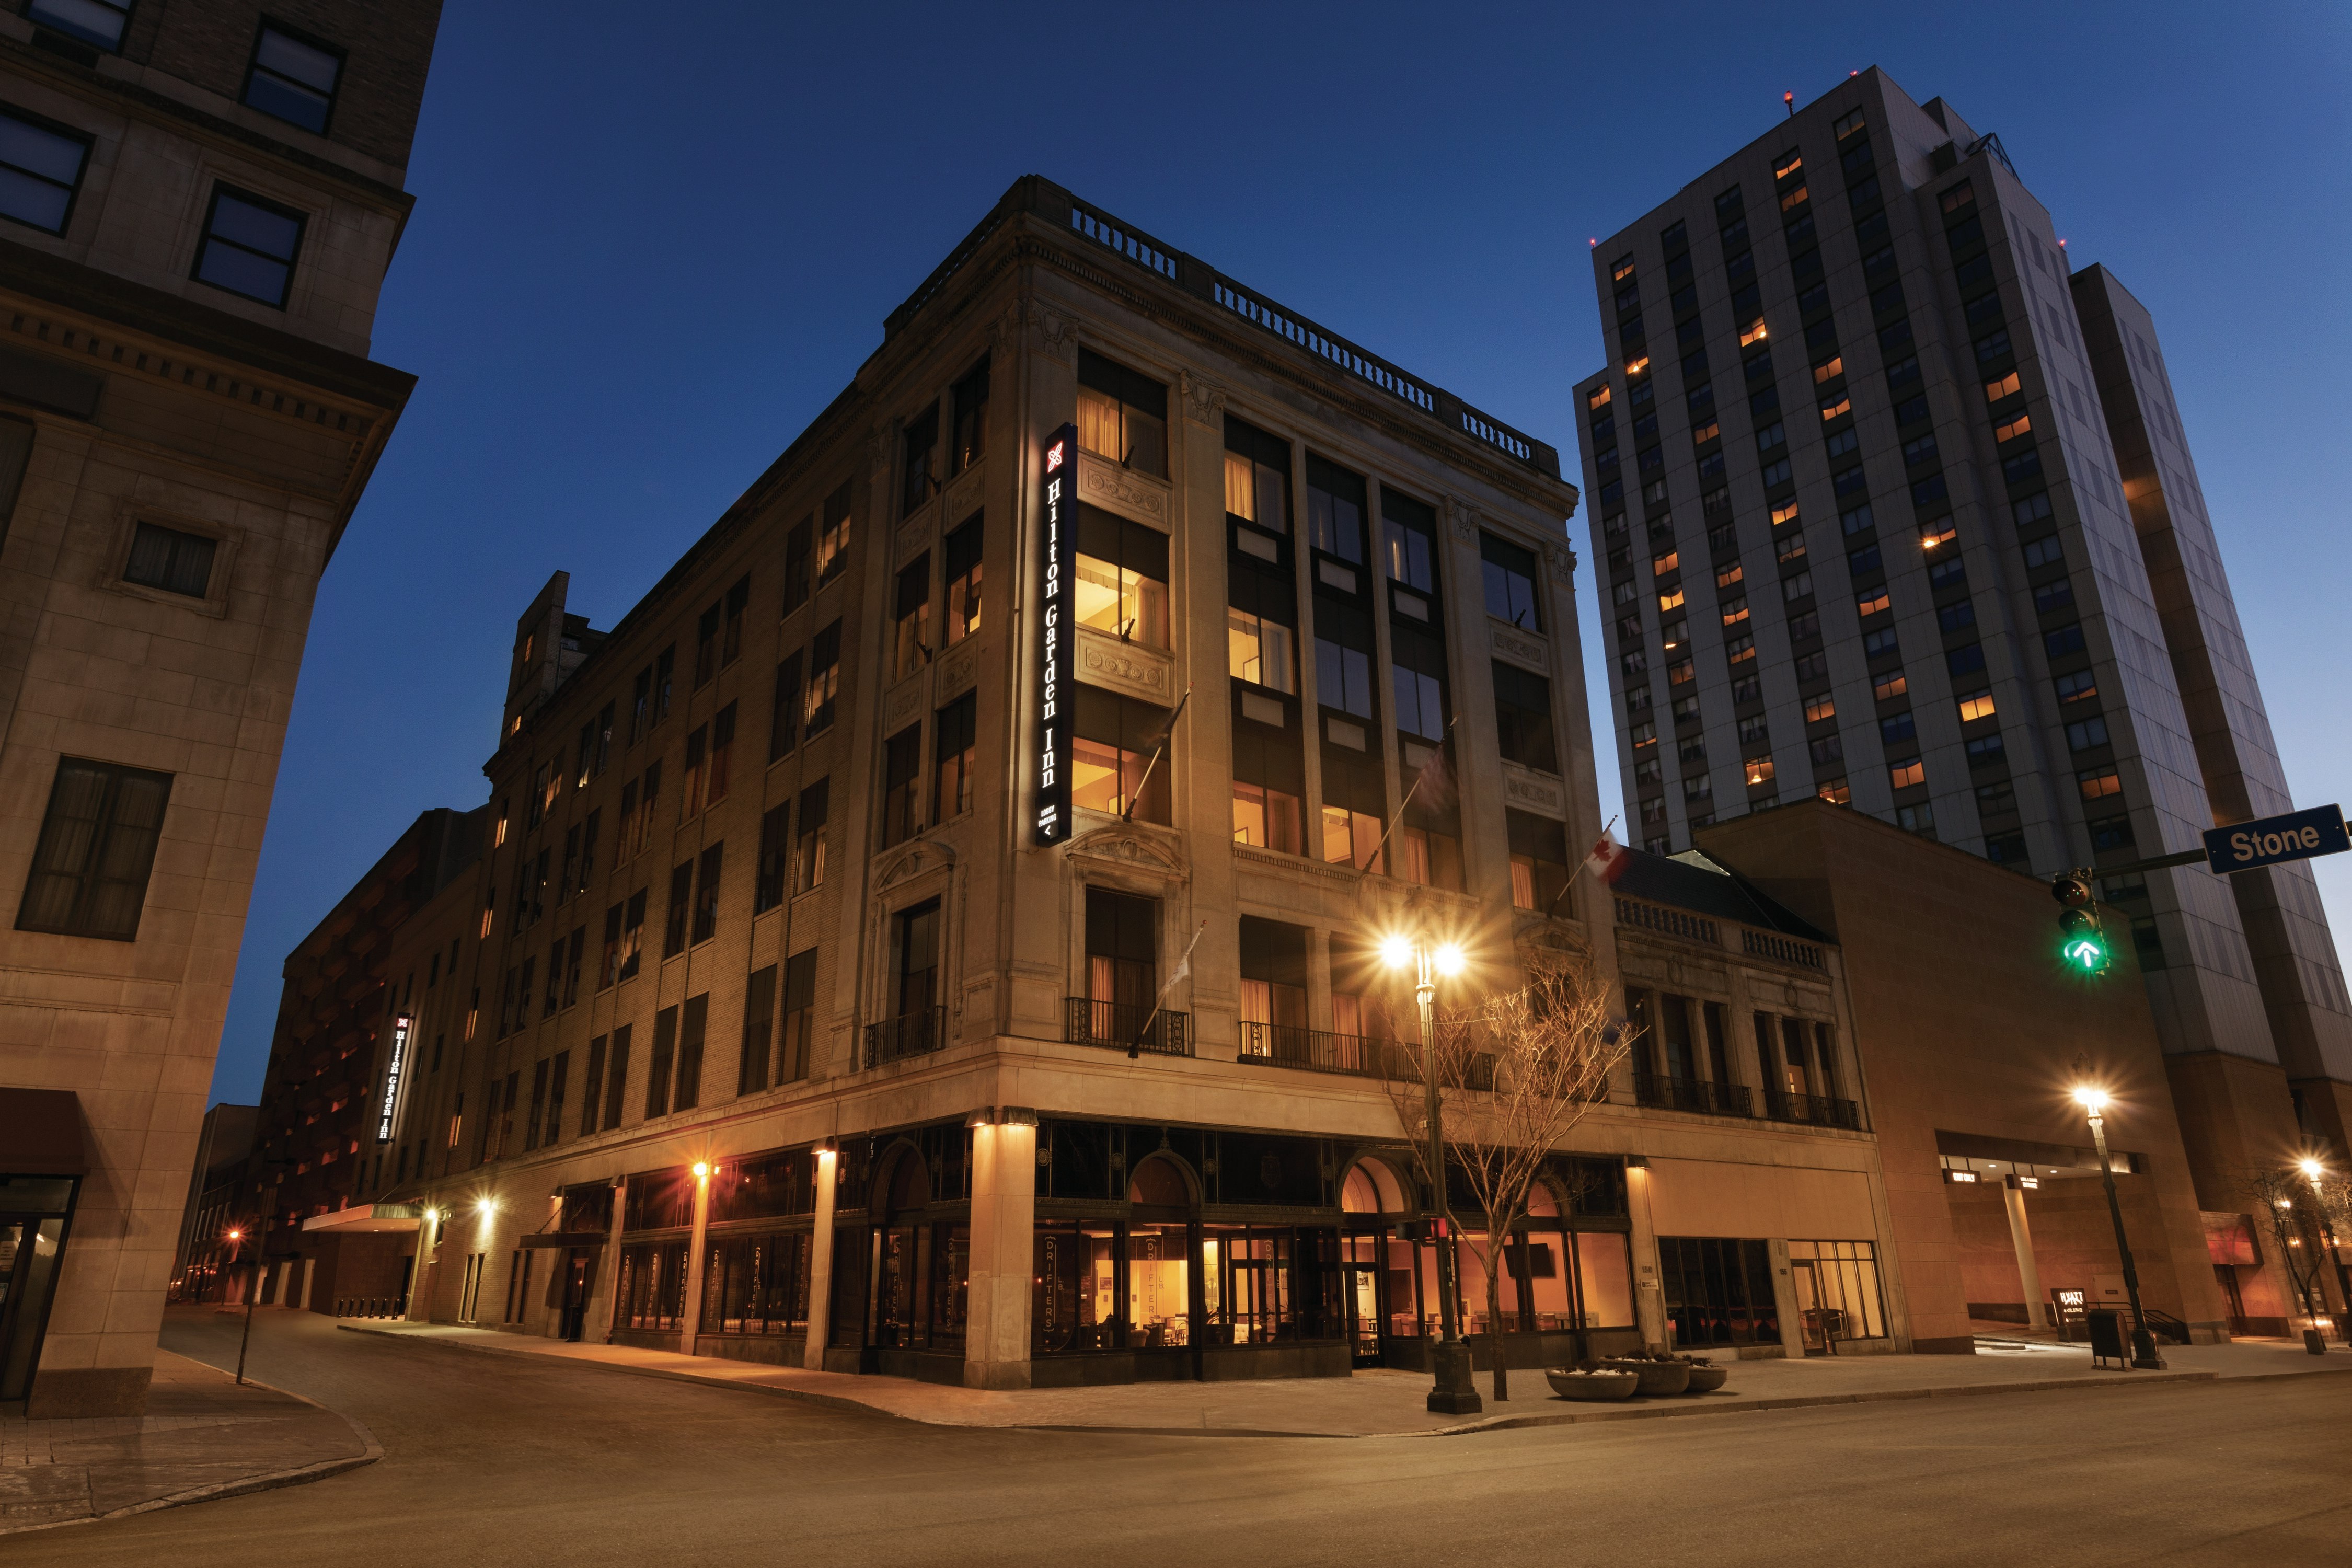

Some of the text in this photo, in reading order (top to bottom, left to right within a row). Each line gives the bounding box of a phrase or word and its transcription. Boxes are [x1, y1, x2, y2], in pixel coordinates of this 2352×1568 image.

[1042, 478, 1061, 788] Hilton Garden Inn
[1039, 813, 1056, 827] PARKING
[1041, 805, 1055, 817] LOBBY
[2230, 826, 2320, 861] Stone
[379, 1031, 406, 1138] Hilton Garden Inn
[751, 1251, 759, 1318] DRIFTERS
[2060, 1292, 2083, 1305] HYATT
